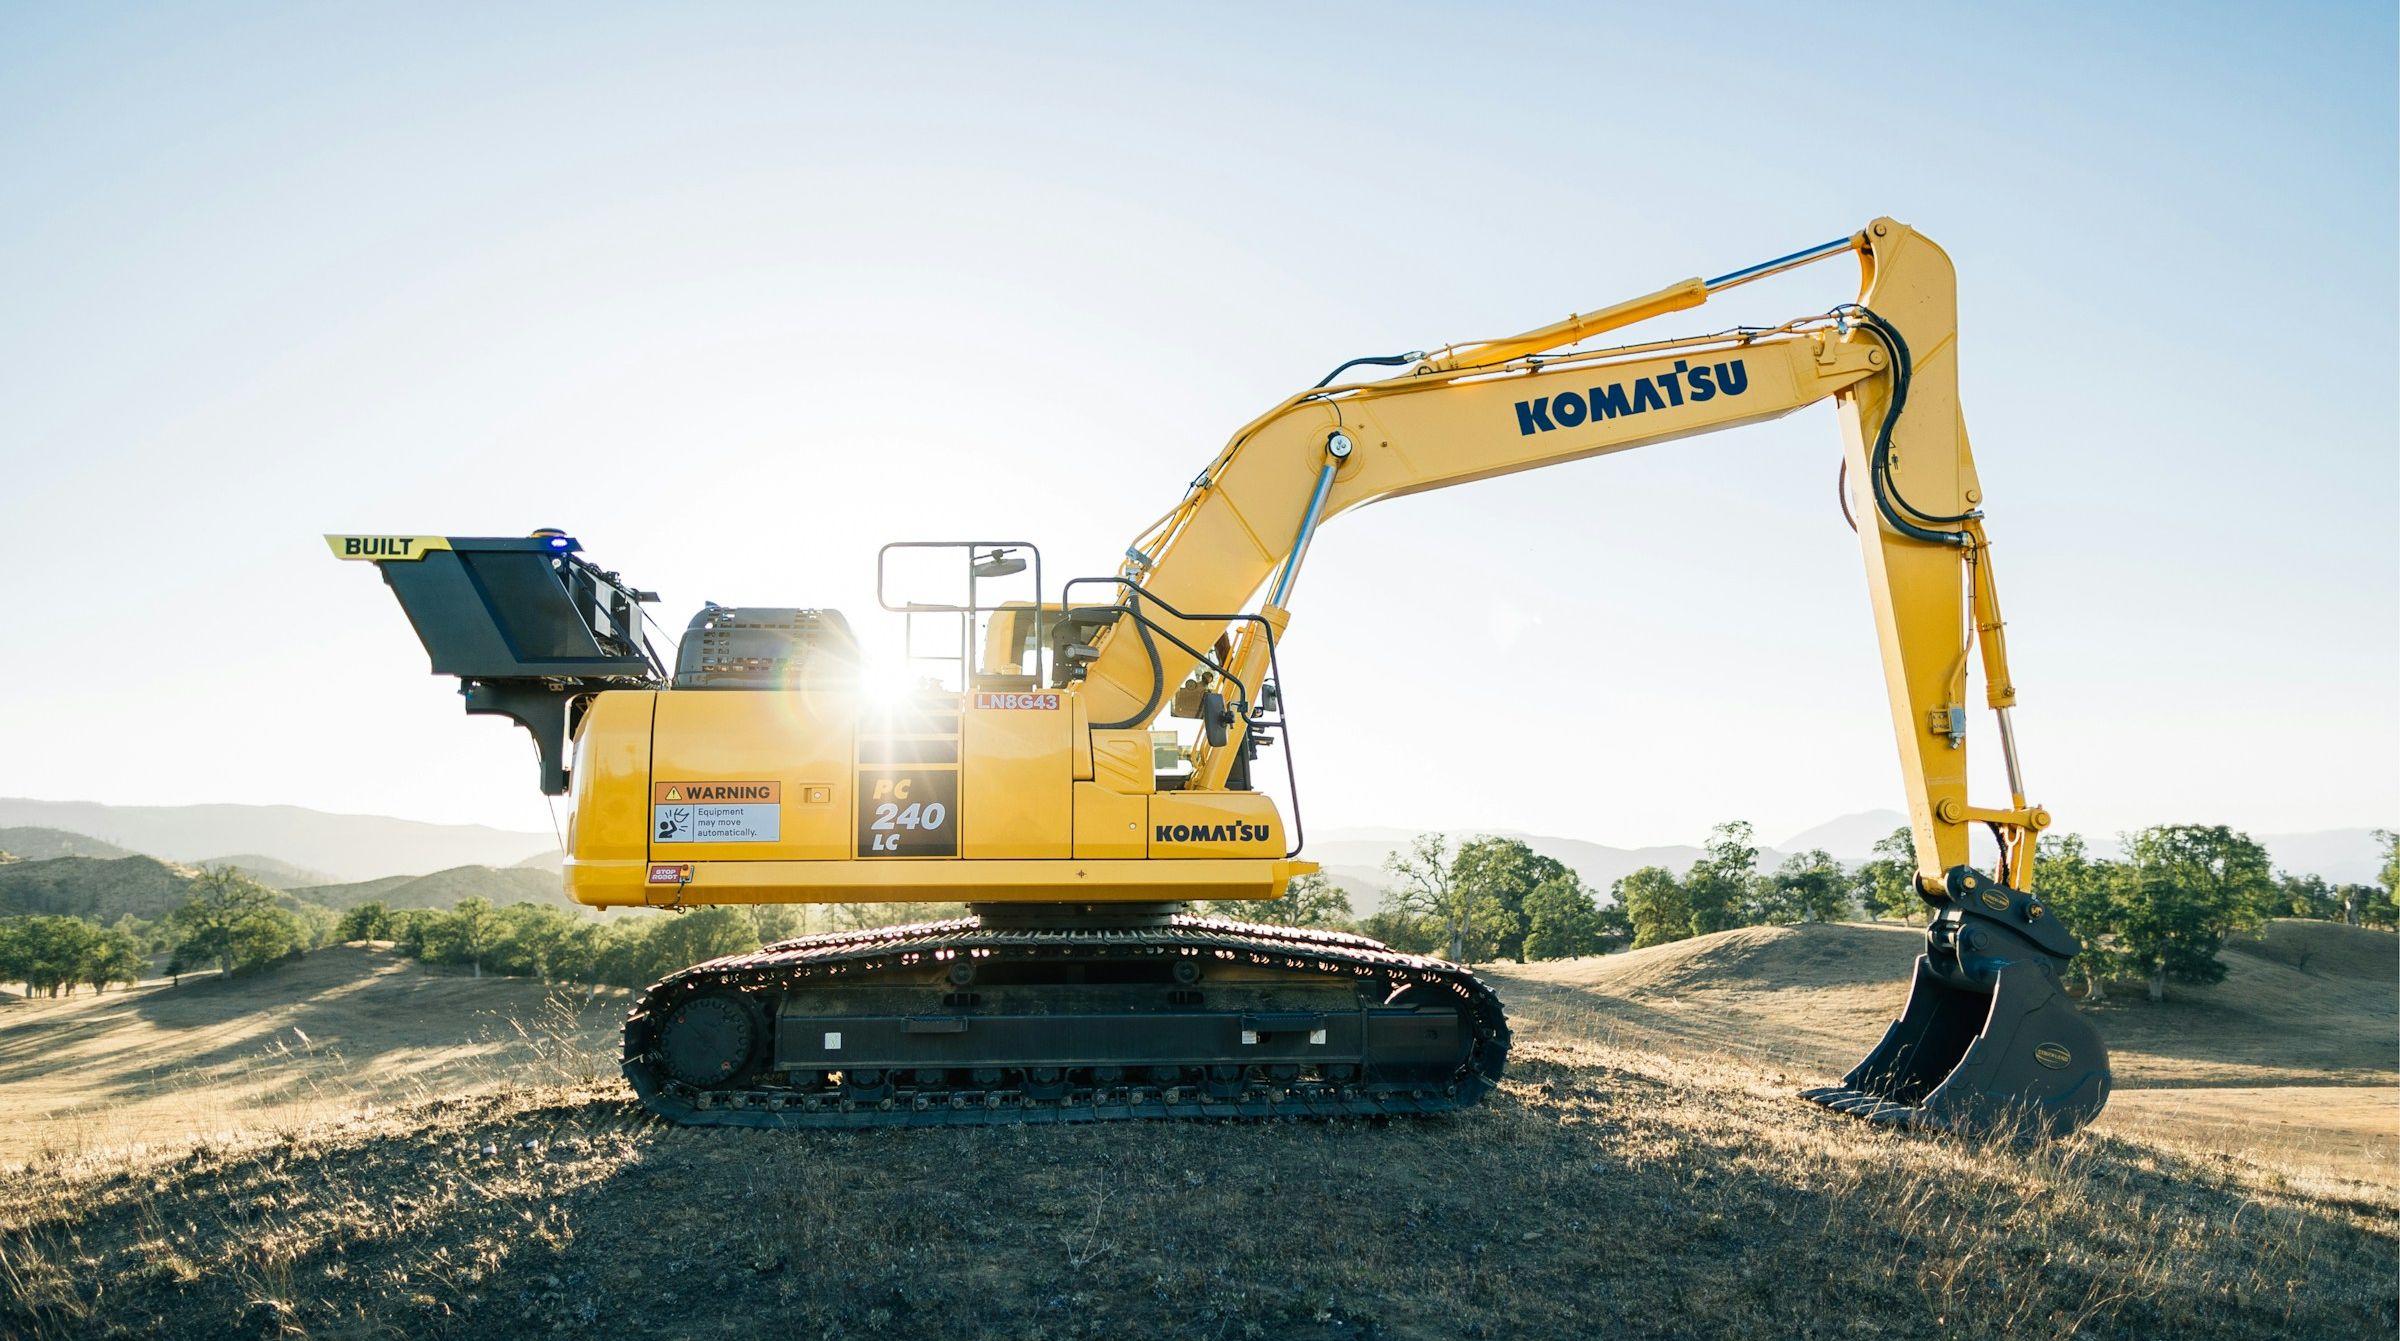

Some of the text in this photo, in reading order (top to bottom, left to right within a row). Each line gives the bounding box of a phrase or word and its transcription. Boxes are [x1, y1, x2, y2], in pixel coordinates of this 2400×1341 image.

[1514, 359, 1749, 436] KOMATSU
[345, 537, 414, 555] BUILT
[977, 694, 1057, 710] LN8G43
[686, 786, 771, 799] WARNING
[872, 778, 912, 800] PC
[698, 808, 744, 817] Equipment
[871, 802, 946, 830] 240
[697, 828, 757, 838] automatically.
[1156, 820, 1269, 842] KOMATSU
[872, 833, 901, 851] LC
